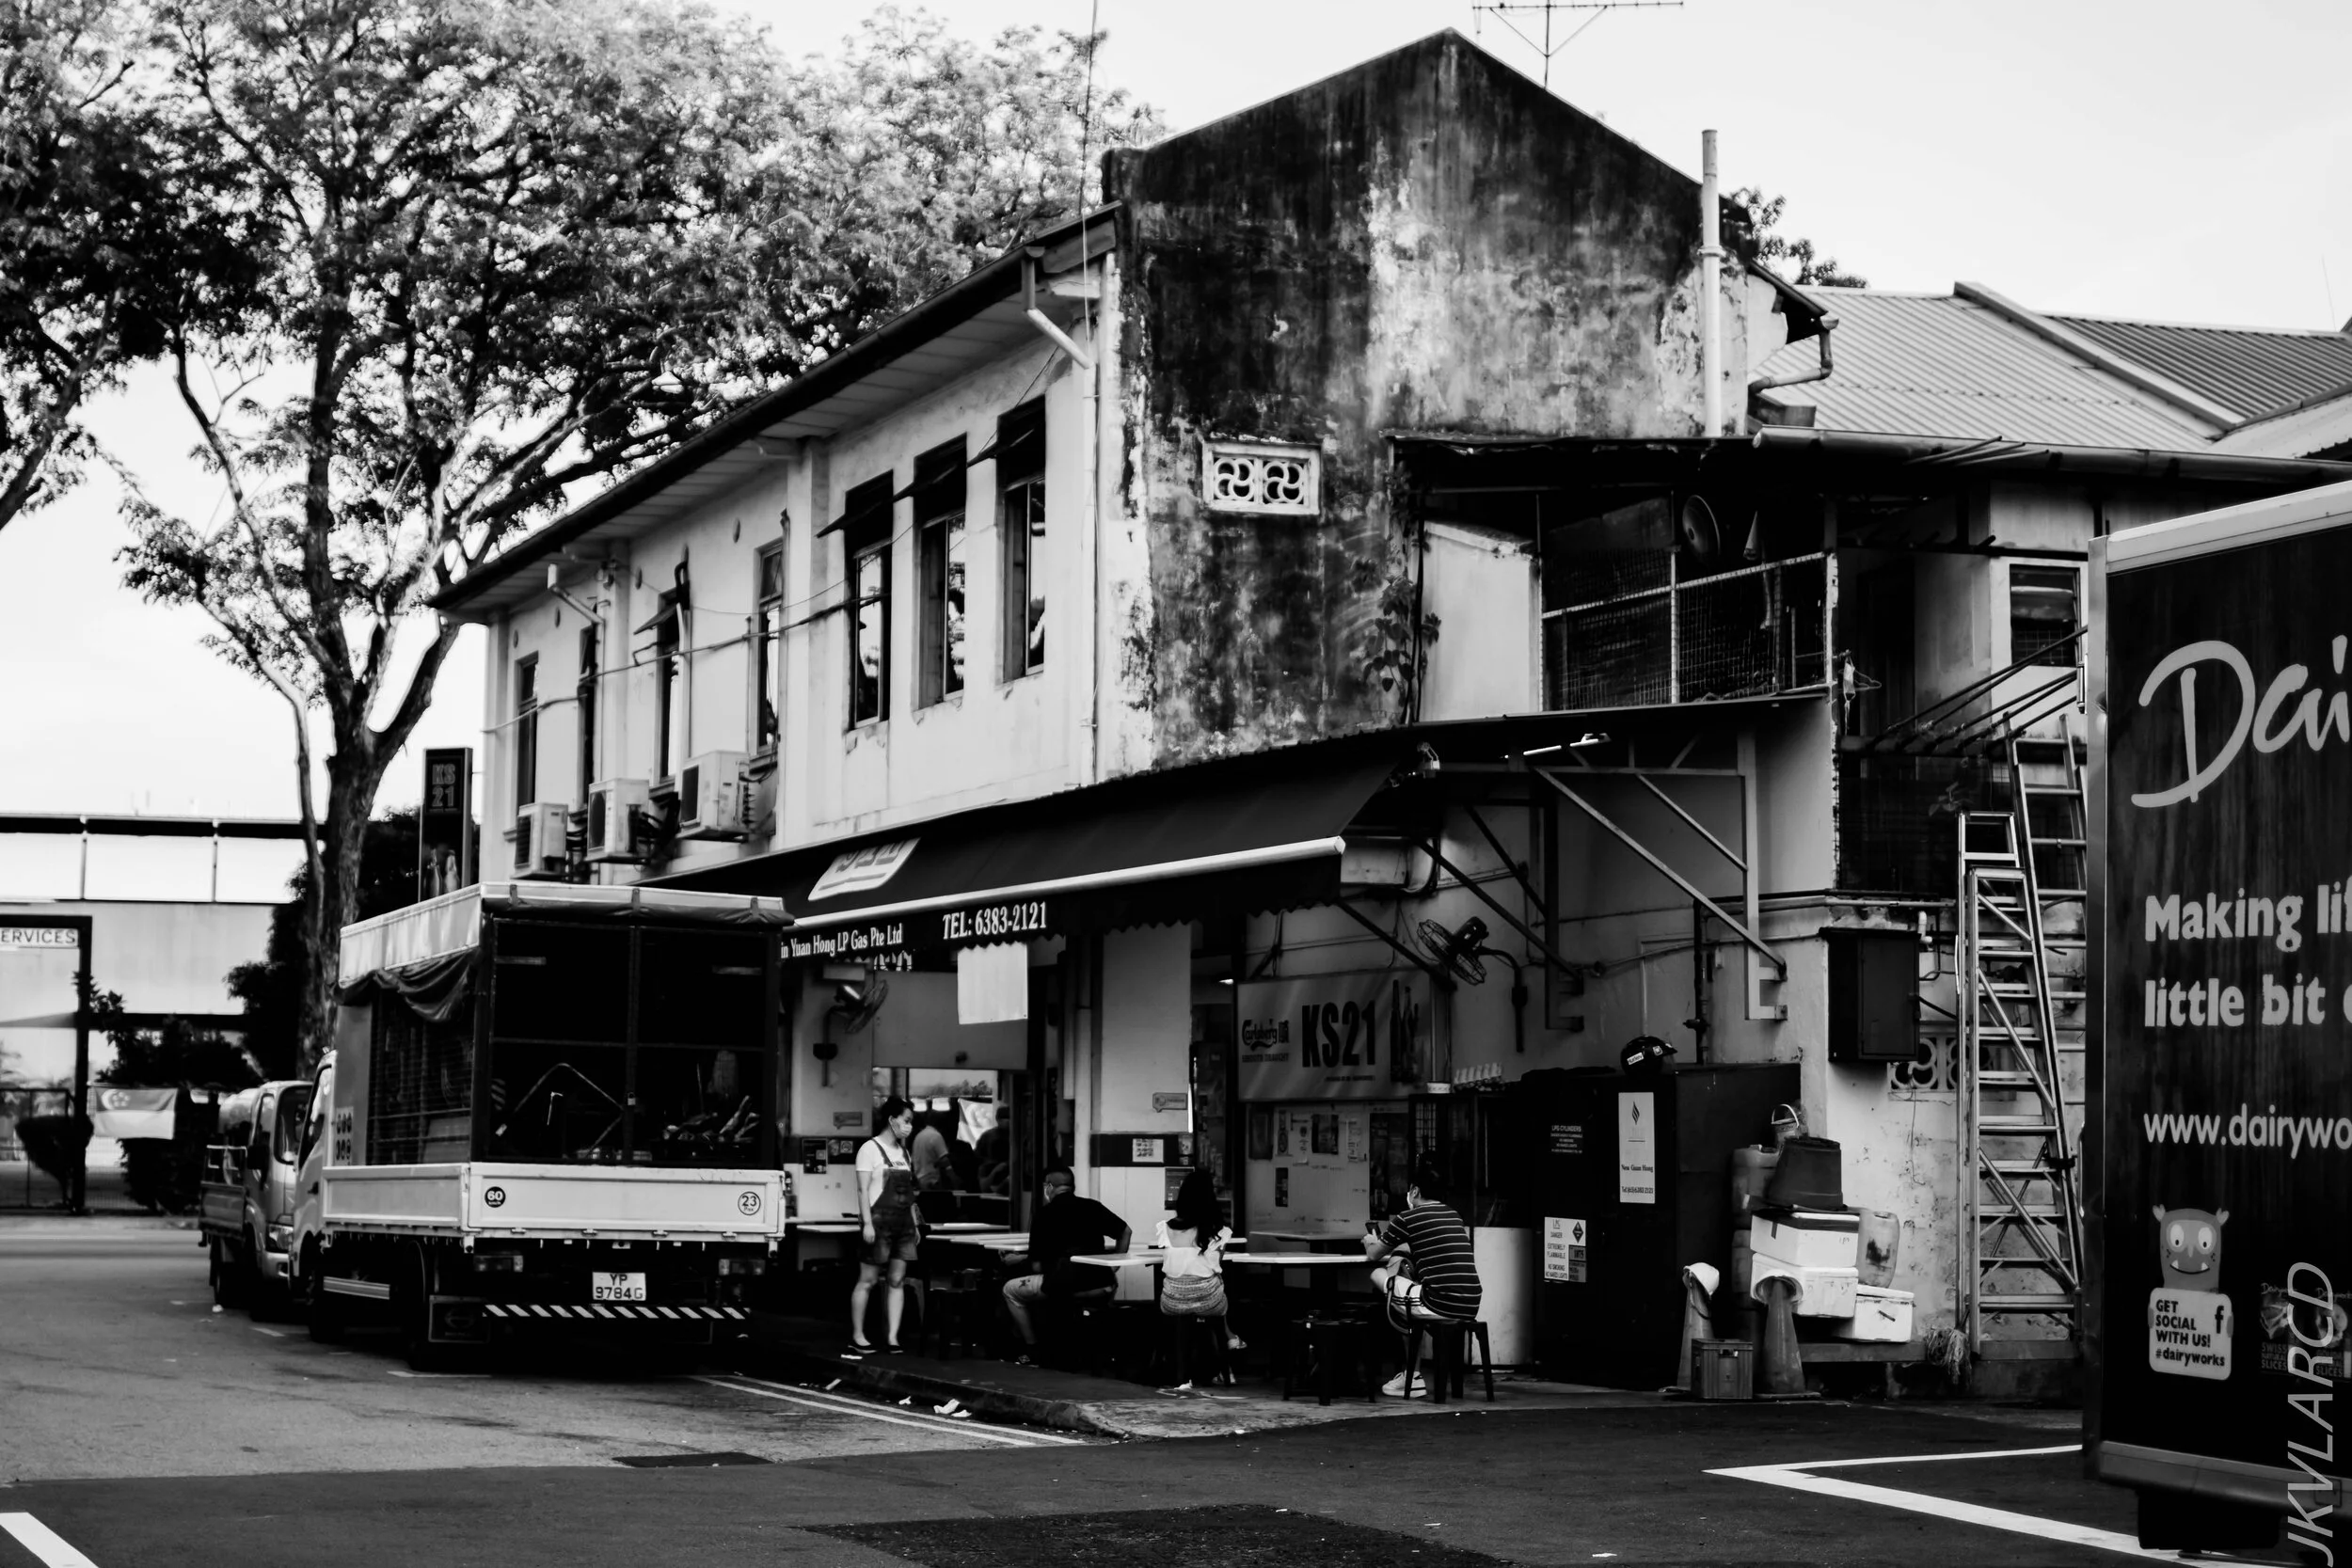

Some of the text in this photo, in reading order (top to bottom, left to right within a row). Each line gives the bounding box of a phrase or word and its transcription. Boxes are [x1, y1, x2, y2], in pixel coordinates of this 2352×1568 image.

[433, 763, 456, 785] KS
[432, 786, 454, 807] 21
[943, 901, 1046, 940] TEL: 6383-2121
[2144, 887, 2304, 953] Making
[791, 938, 811, 958] Yuan
[813, 935, 835, 958] Hong
[837, 930, 849, 952] LP
[850, 929, 868, 950] Gas
[870, 927, 885, 947] Pte
[887, 922, 903, 945] Ltd
[2144, 976, 2245, 1027] little
[2261, 973, 2327, 1026] bit
[1301, 1000, 1375, 1068] KS21
[487, 1190, 504, 1201] 60
[741, 1195, 757, 1207] 23
[610, 1274, 628, 1286] YP
[596, 1286, 644, 1299] 9784G
[2155, 1299, 2179, 1313] GET
[2155, 1314, 2197, 1331] SOCIAL
[2214, 1305, 2225, 1334] f
[2155, 1329, 2212, 1348] WITH US!
[2155, 1347, 2226, 1368] #dairyworks
